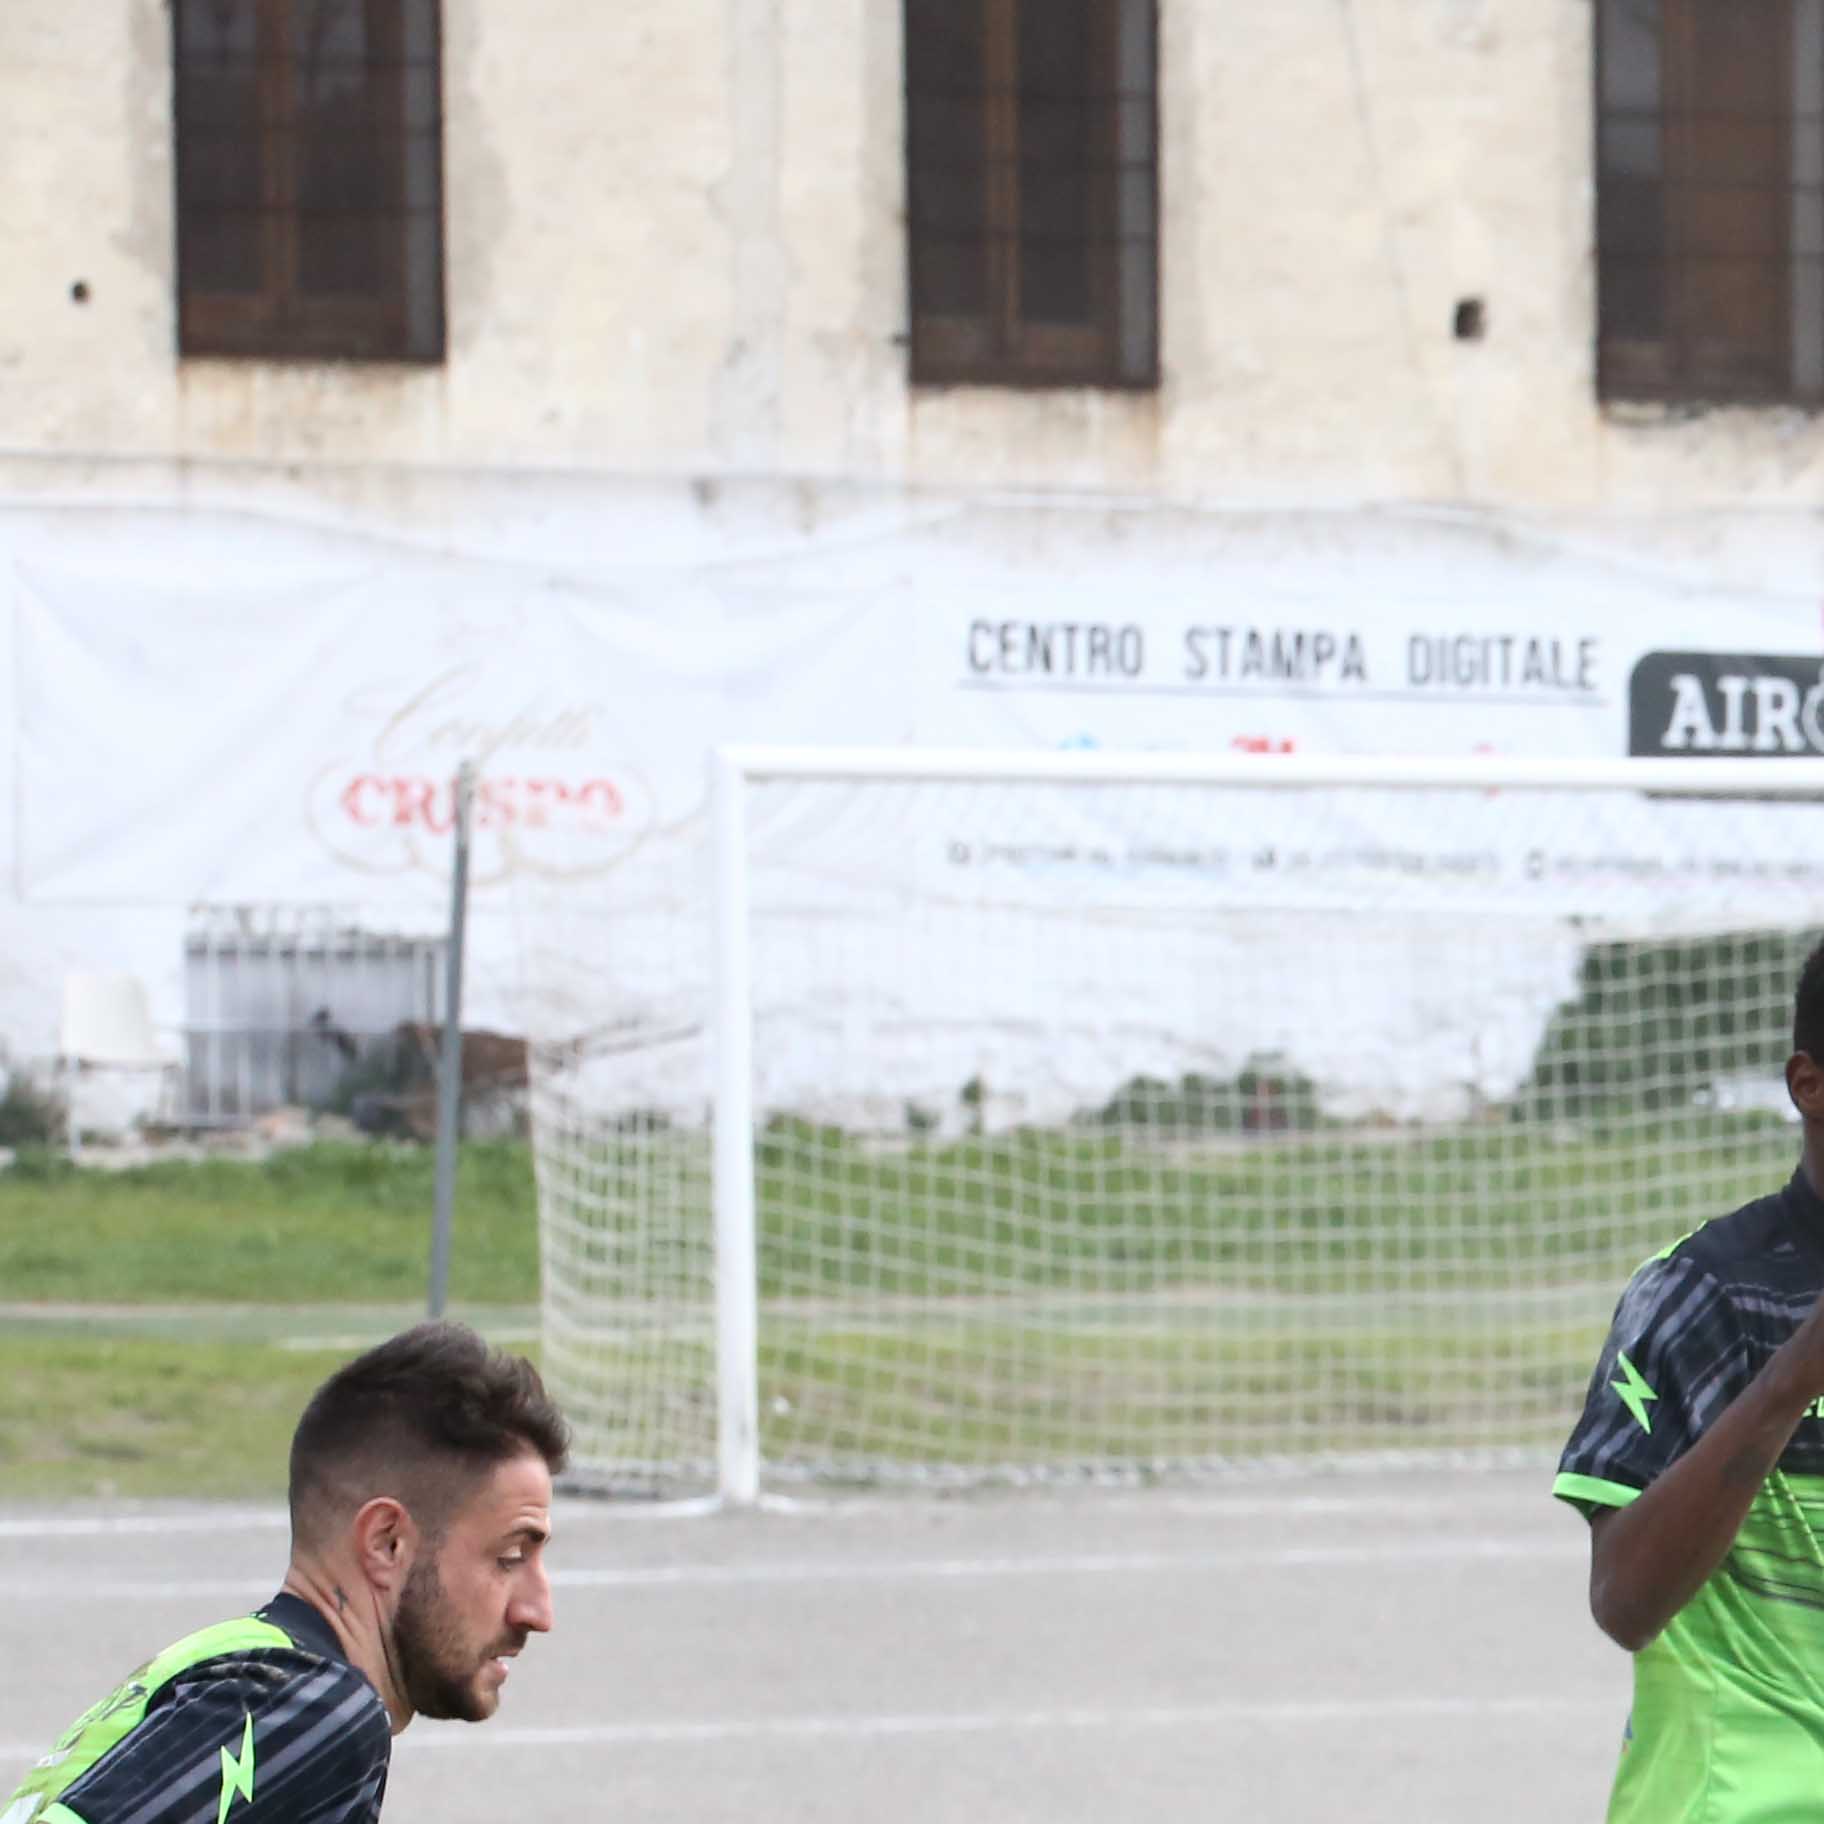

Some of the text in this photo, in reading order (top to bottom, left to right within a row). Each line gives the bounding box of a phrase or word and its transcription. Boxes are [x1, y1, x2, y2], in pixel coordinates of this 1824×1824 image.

[966, 619, 1599, 691] CENTRO STAMPA DIGITALE
